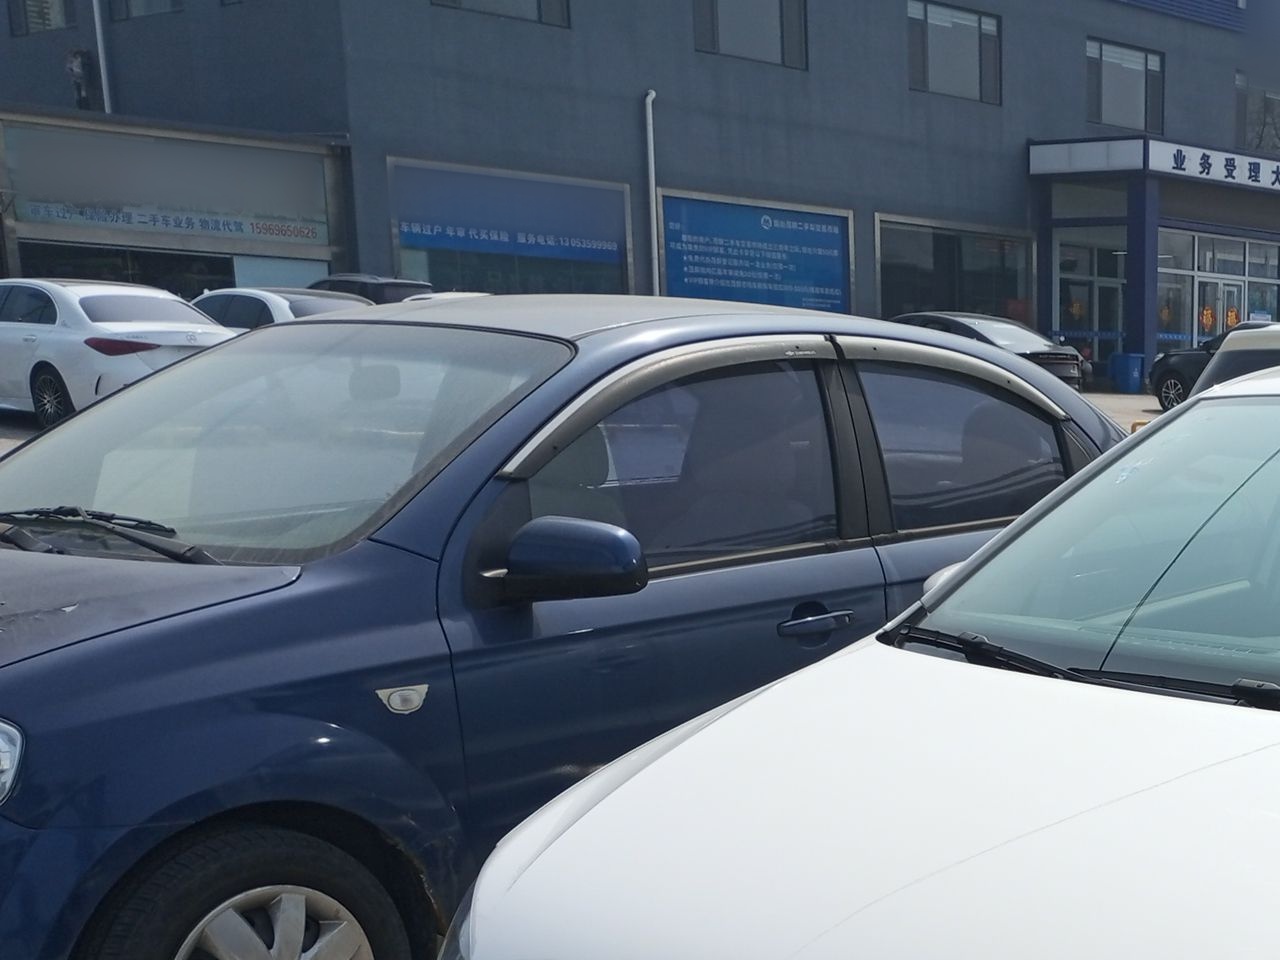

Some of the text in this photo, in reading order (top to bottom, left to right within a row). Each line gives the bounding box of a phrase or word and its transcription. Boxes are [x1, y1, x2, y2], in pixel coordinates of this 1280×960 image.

[137, 212, 195, 230] 二手车业务
